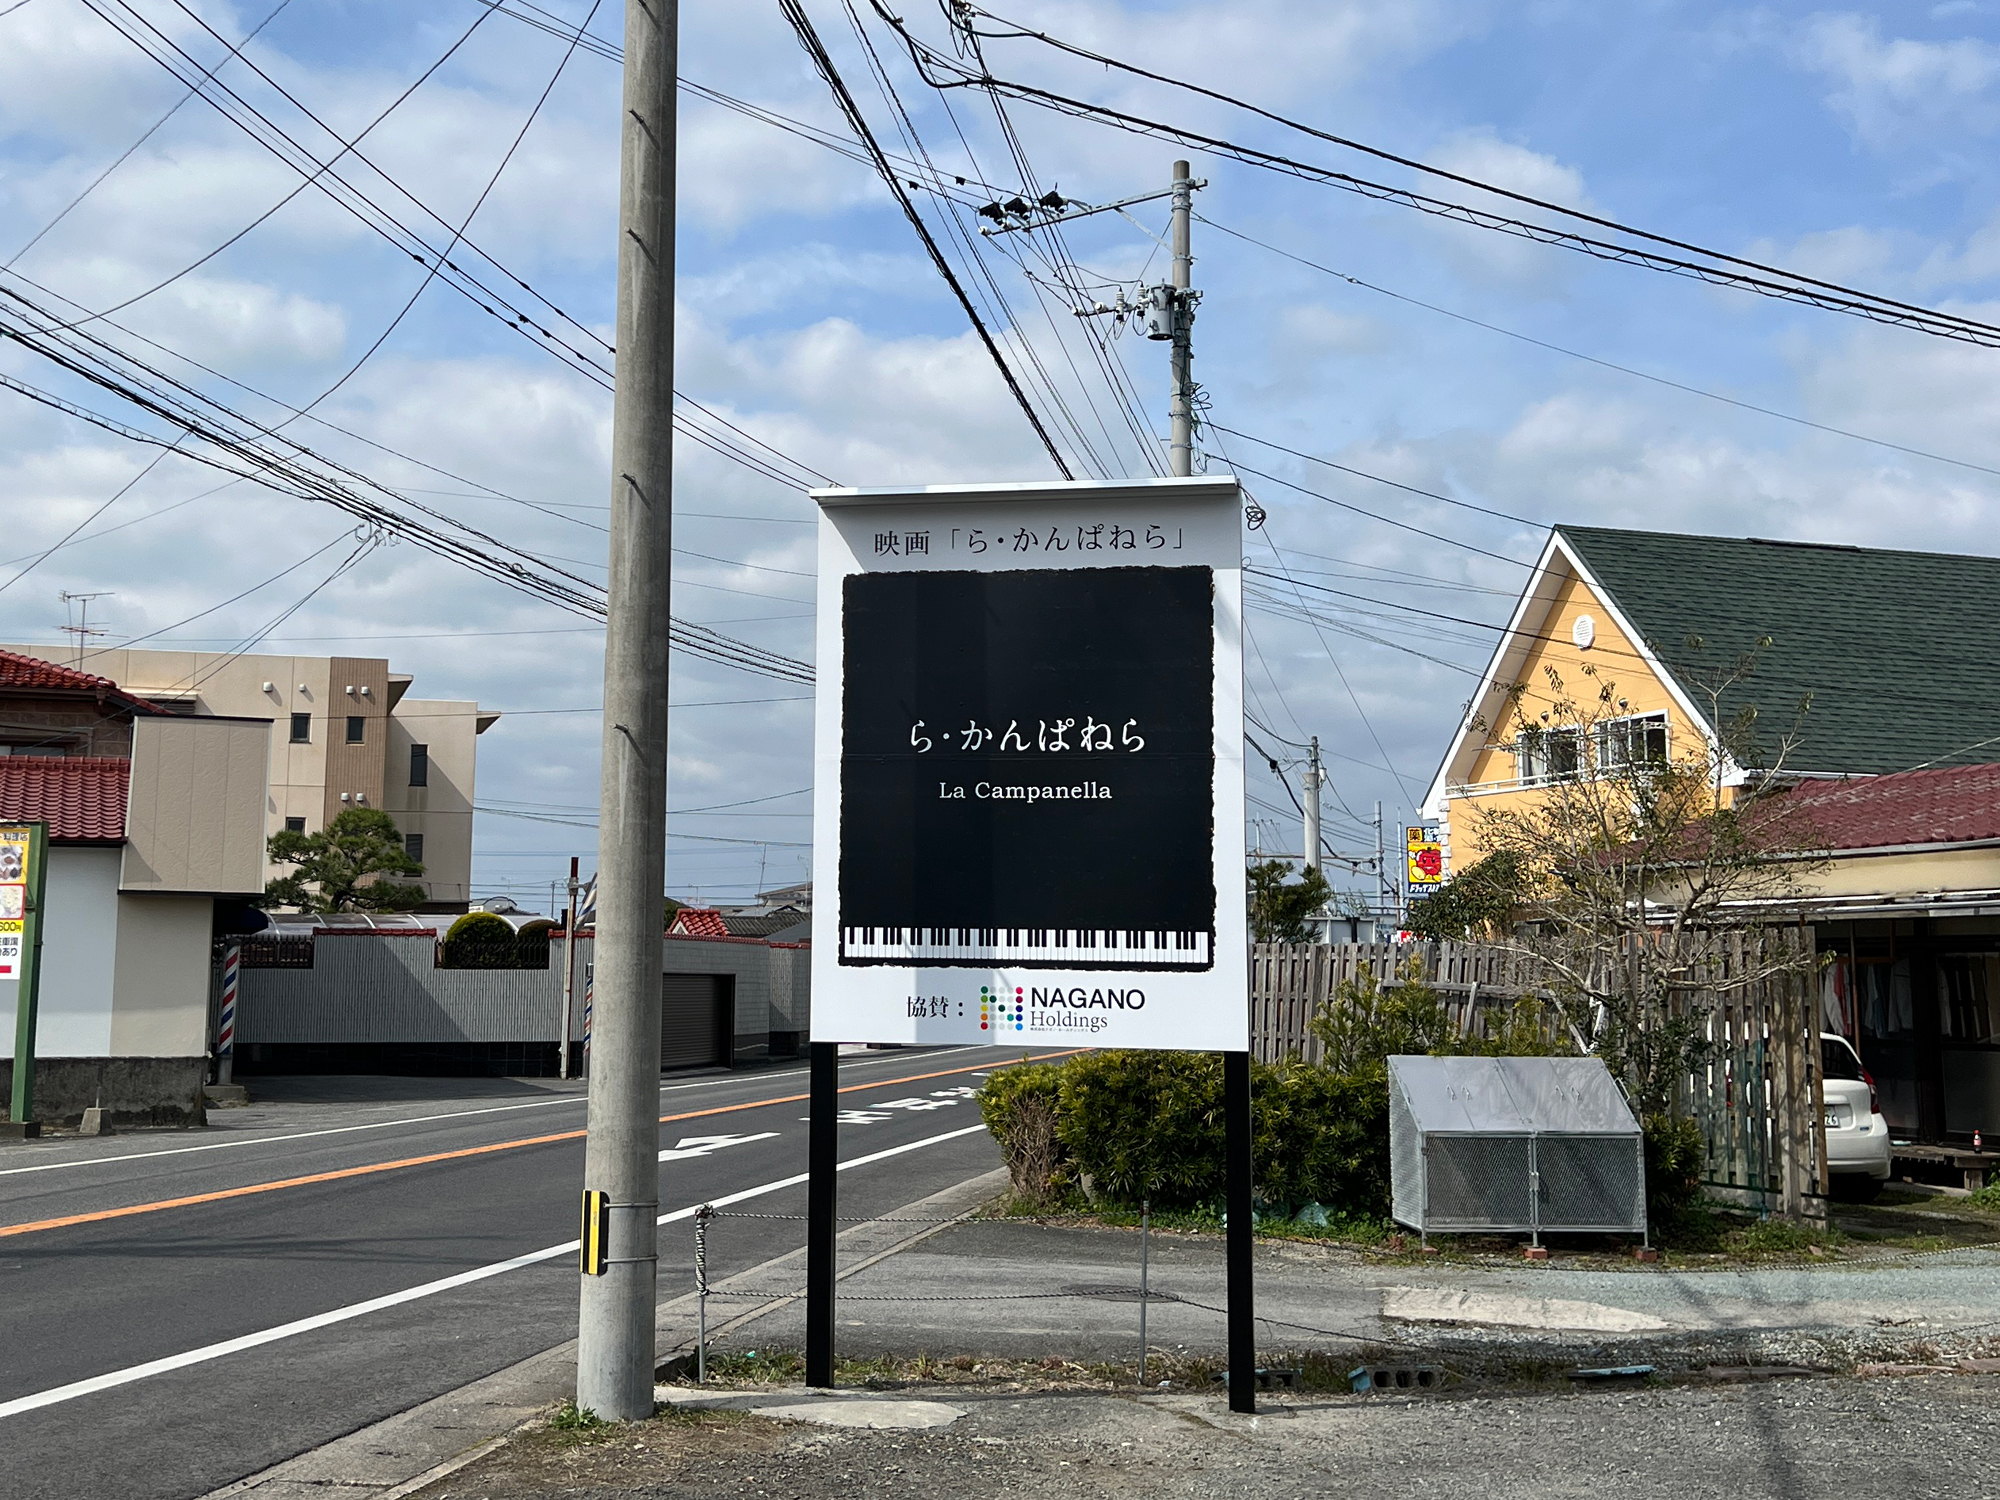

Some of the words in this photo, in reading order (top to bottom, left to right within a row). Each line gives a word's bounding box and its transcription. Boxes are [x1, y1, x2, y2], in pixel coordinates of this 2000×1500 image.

[910, 715, 1146, 753] ら・かんぱねら
[939, 782, 966, 799] La
[975, 782, 1113, 804] Campanella
[0, 947, 17, 957] あり
[1031, 987, 1146, 1010] NAGANO
[1030, 1010, 1108, 1033] Holdings
